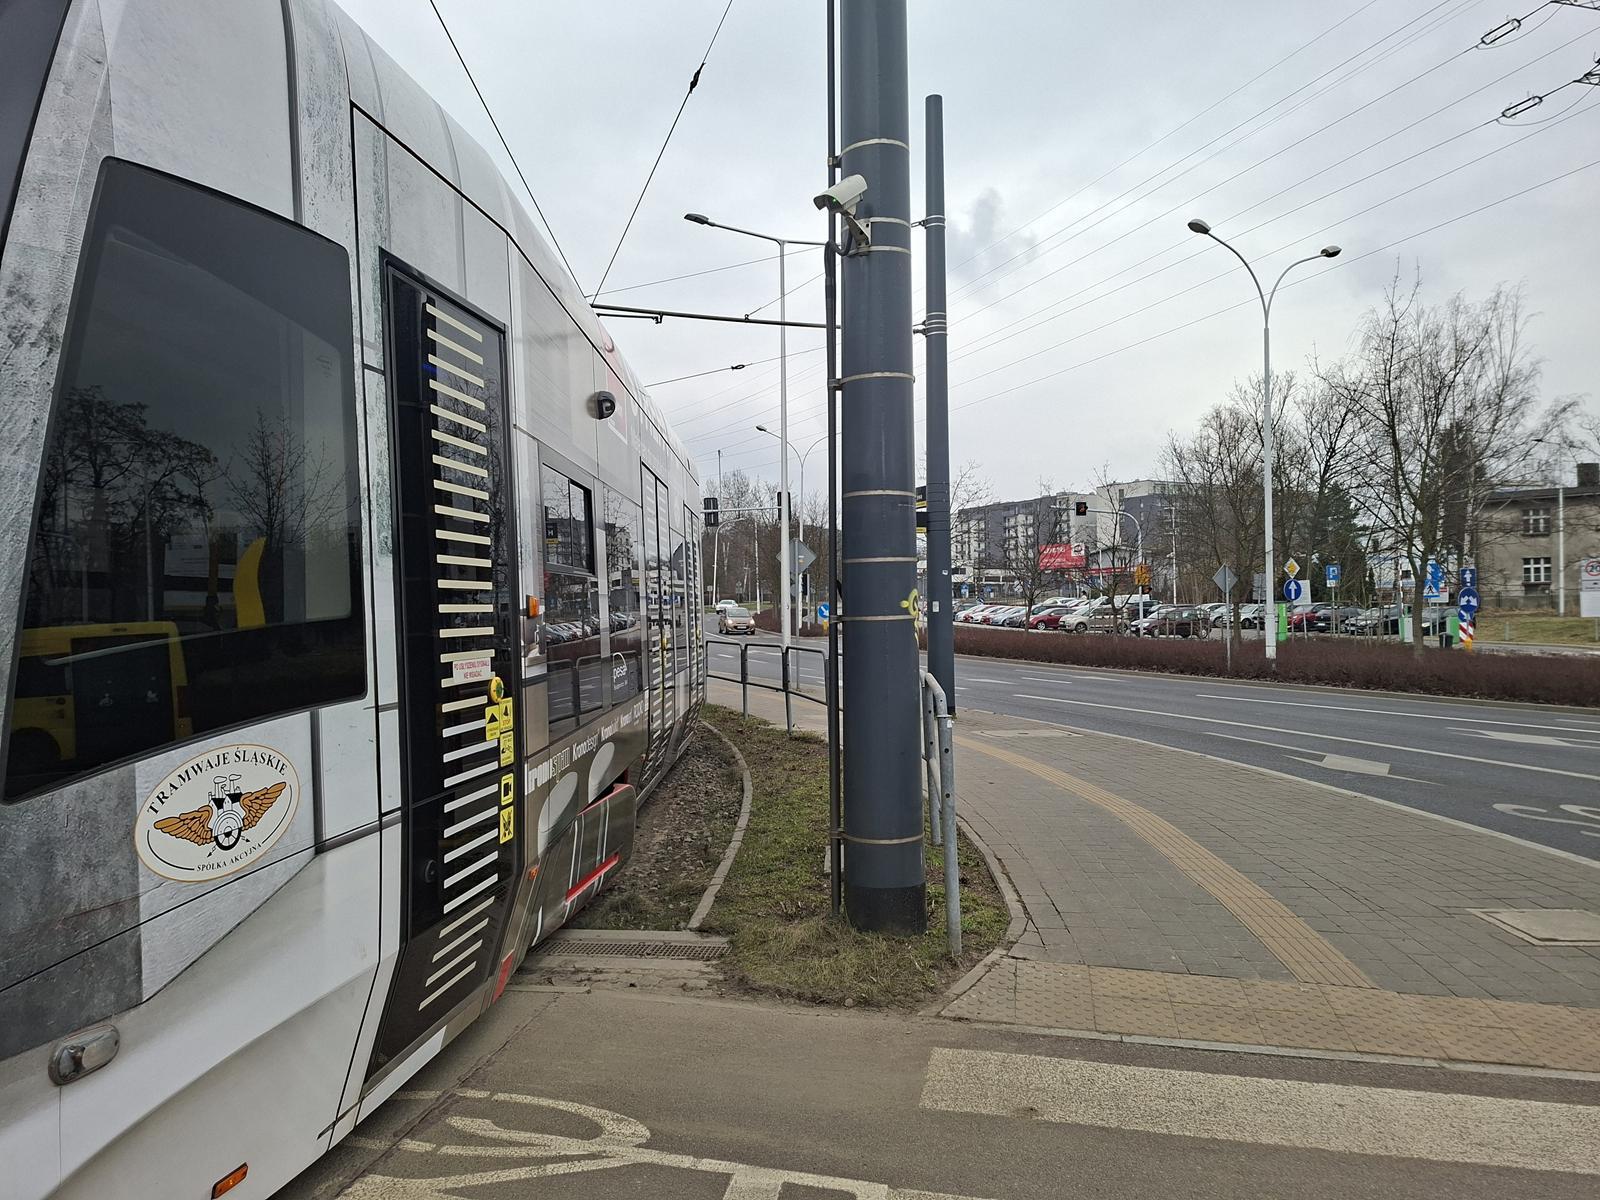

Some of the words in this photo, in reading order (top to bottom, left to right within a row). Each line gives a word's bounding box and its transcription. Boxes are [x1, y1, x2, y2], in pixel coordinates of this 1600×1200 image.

[147, 751, 231, 815] TRAMWAJE
[234, 747, 288, 776] ŚLĄSKIE
[196, 860, 227, 872] SPÓŁKA
[230, 843, 262, 865] AKCYJNA
